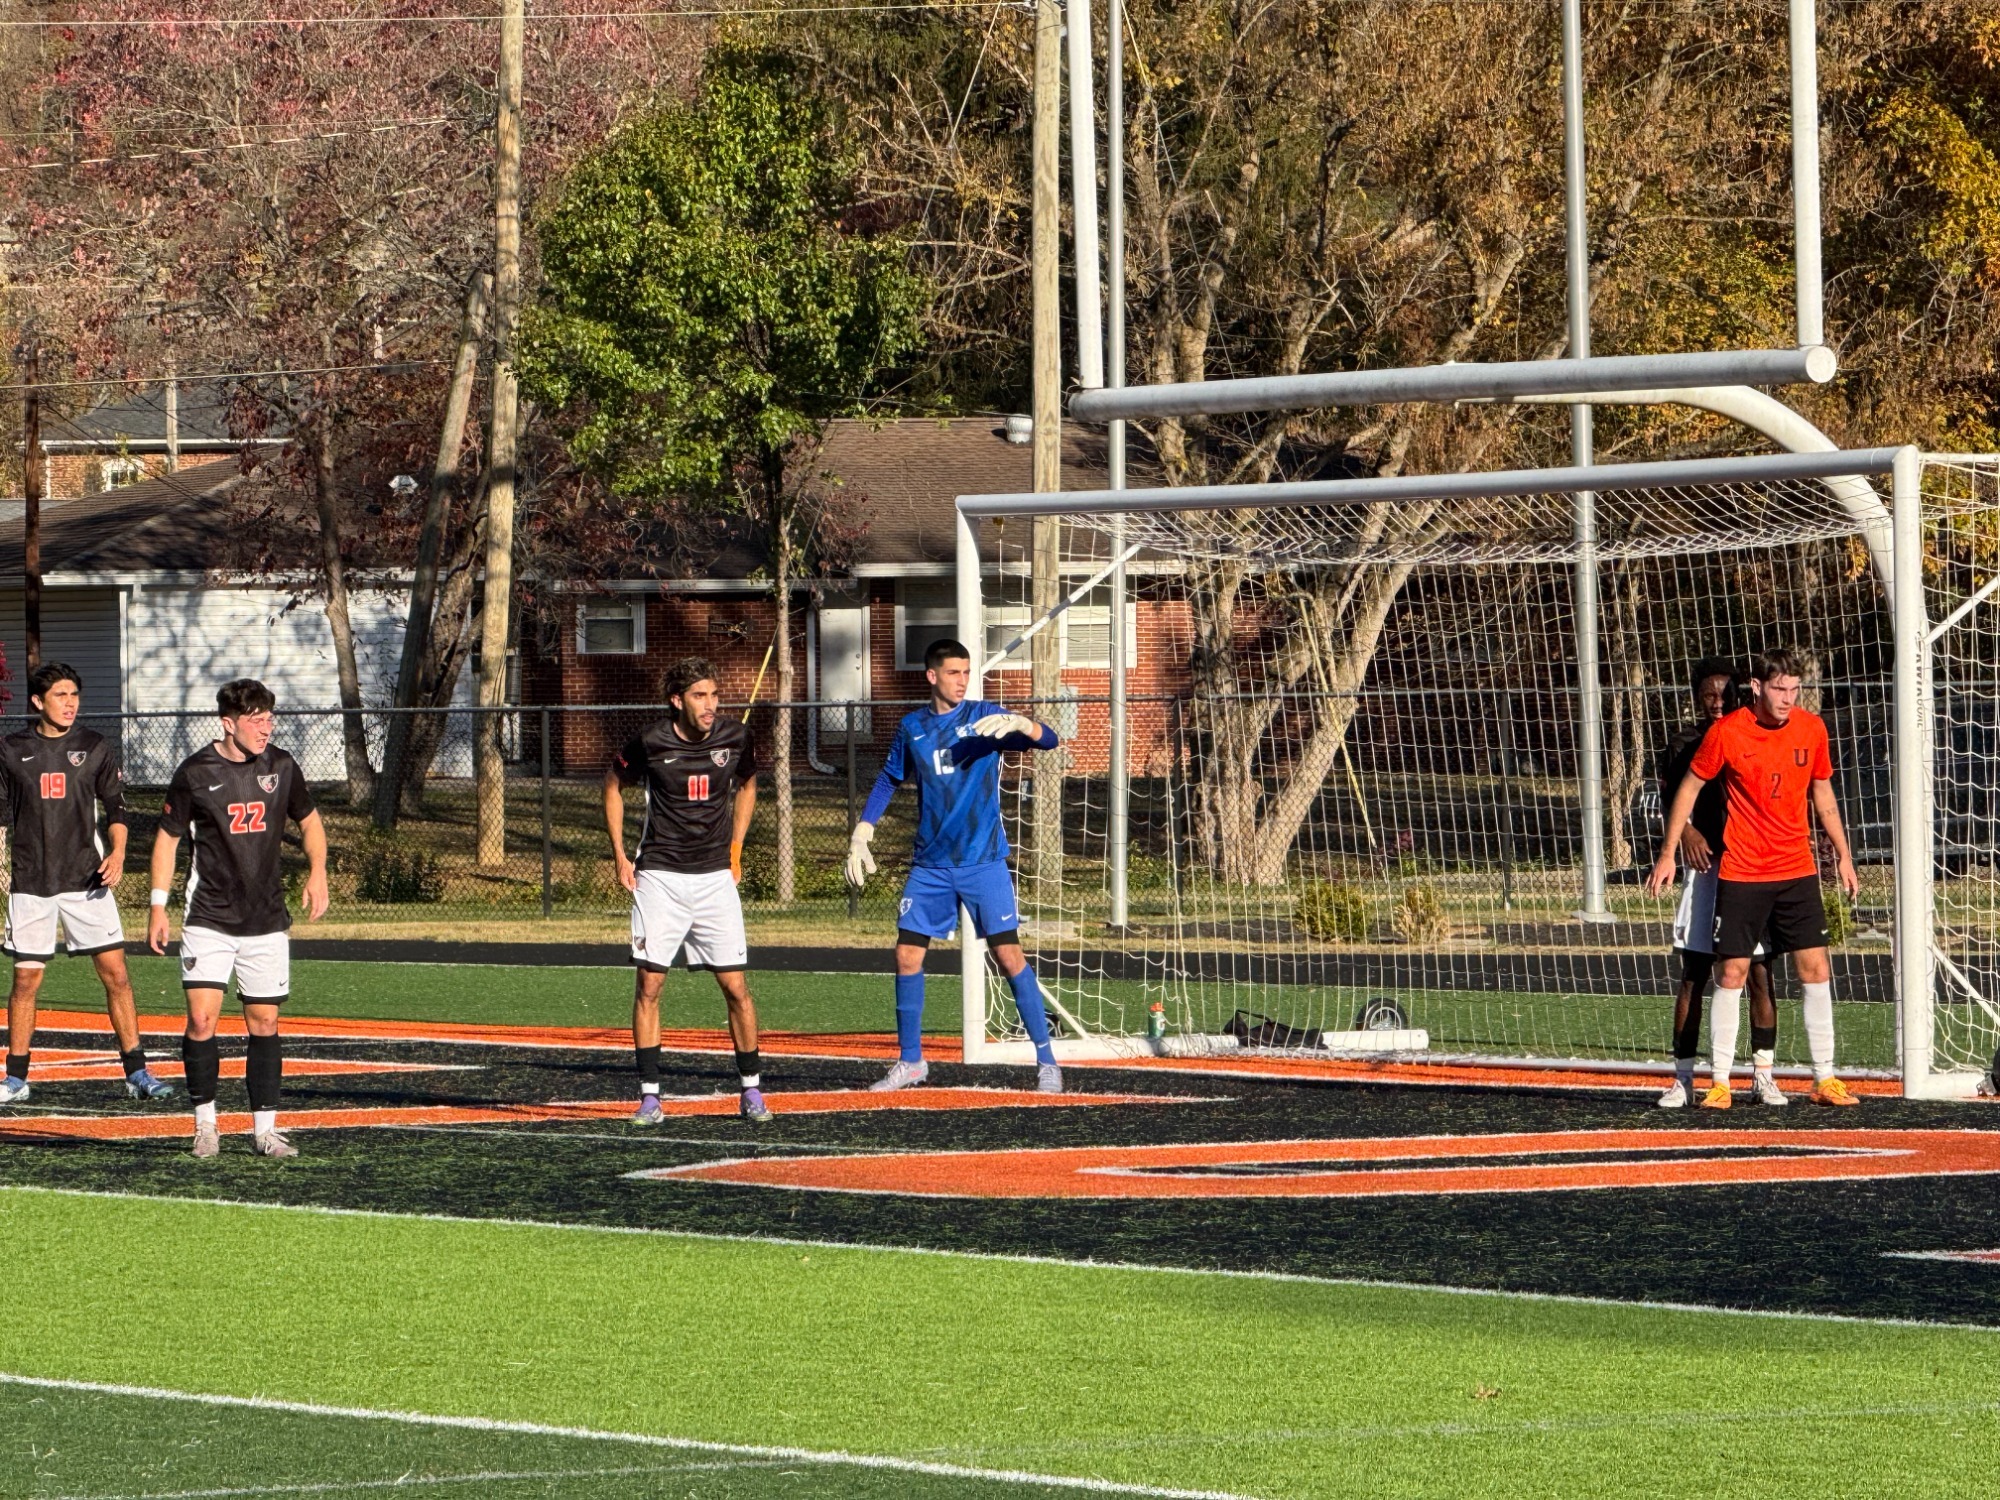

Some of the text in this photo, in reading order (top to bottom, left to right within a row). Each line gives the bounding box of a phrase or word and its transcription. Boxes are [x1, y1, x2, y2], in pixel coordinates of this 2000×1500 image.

[1795, 749, 1808, 767] U
[40, 773, 66, 799] 19
[688, 775, 709, 800] 11
[1770, 772, 1781, 799] 2
[227, 801, 267, 835] 22
